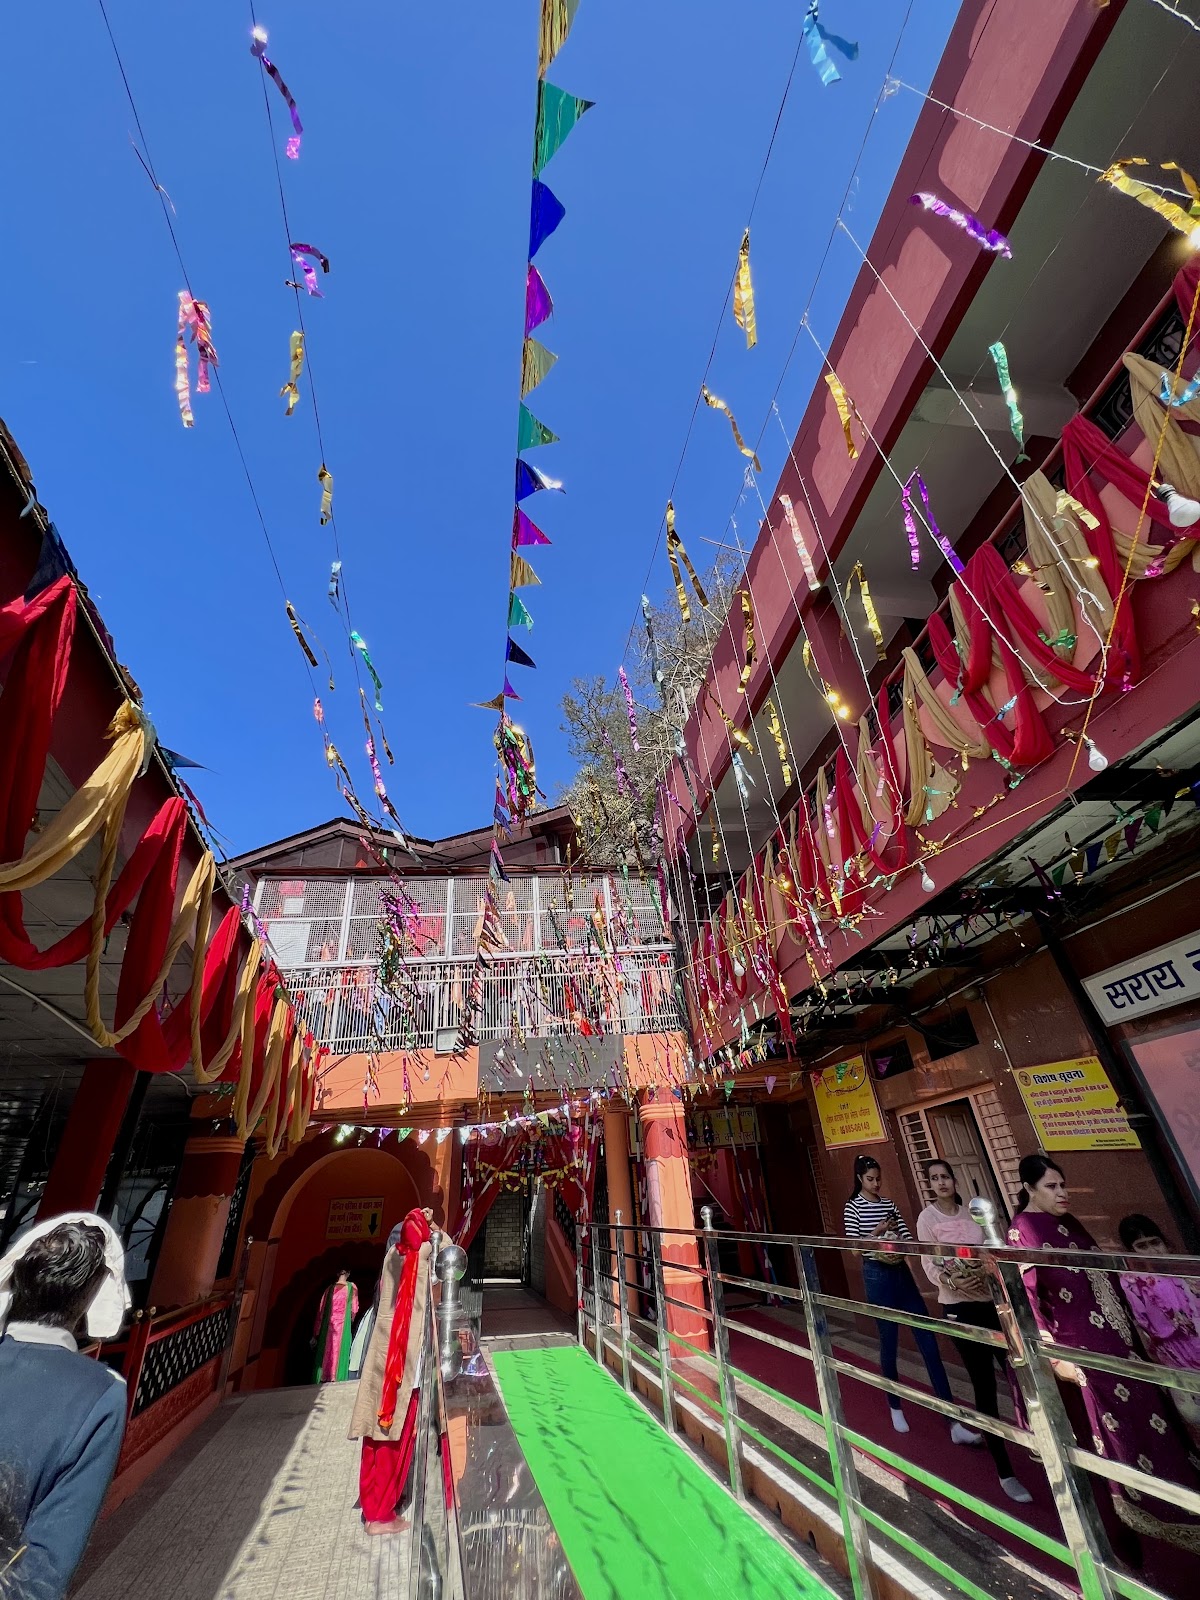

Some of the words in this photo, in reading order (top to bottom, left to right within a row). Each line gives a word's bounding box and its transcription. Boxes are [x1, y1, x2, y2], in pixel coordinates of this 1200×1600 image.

[1102, 960, 1185, 1009] सराय
[1033, 1072, 1058, 1085] विशेष
[1059, 1069, 1085, 1084] सूचना
